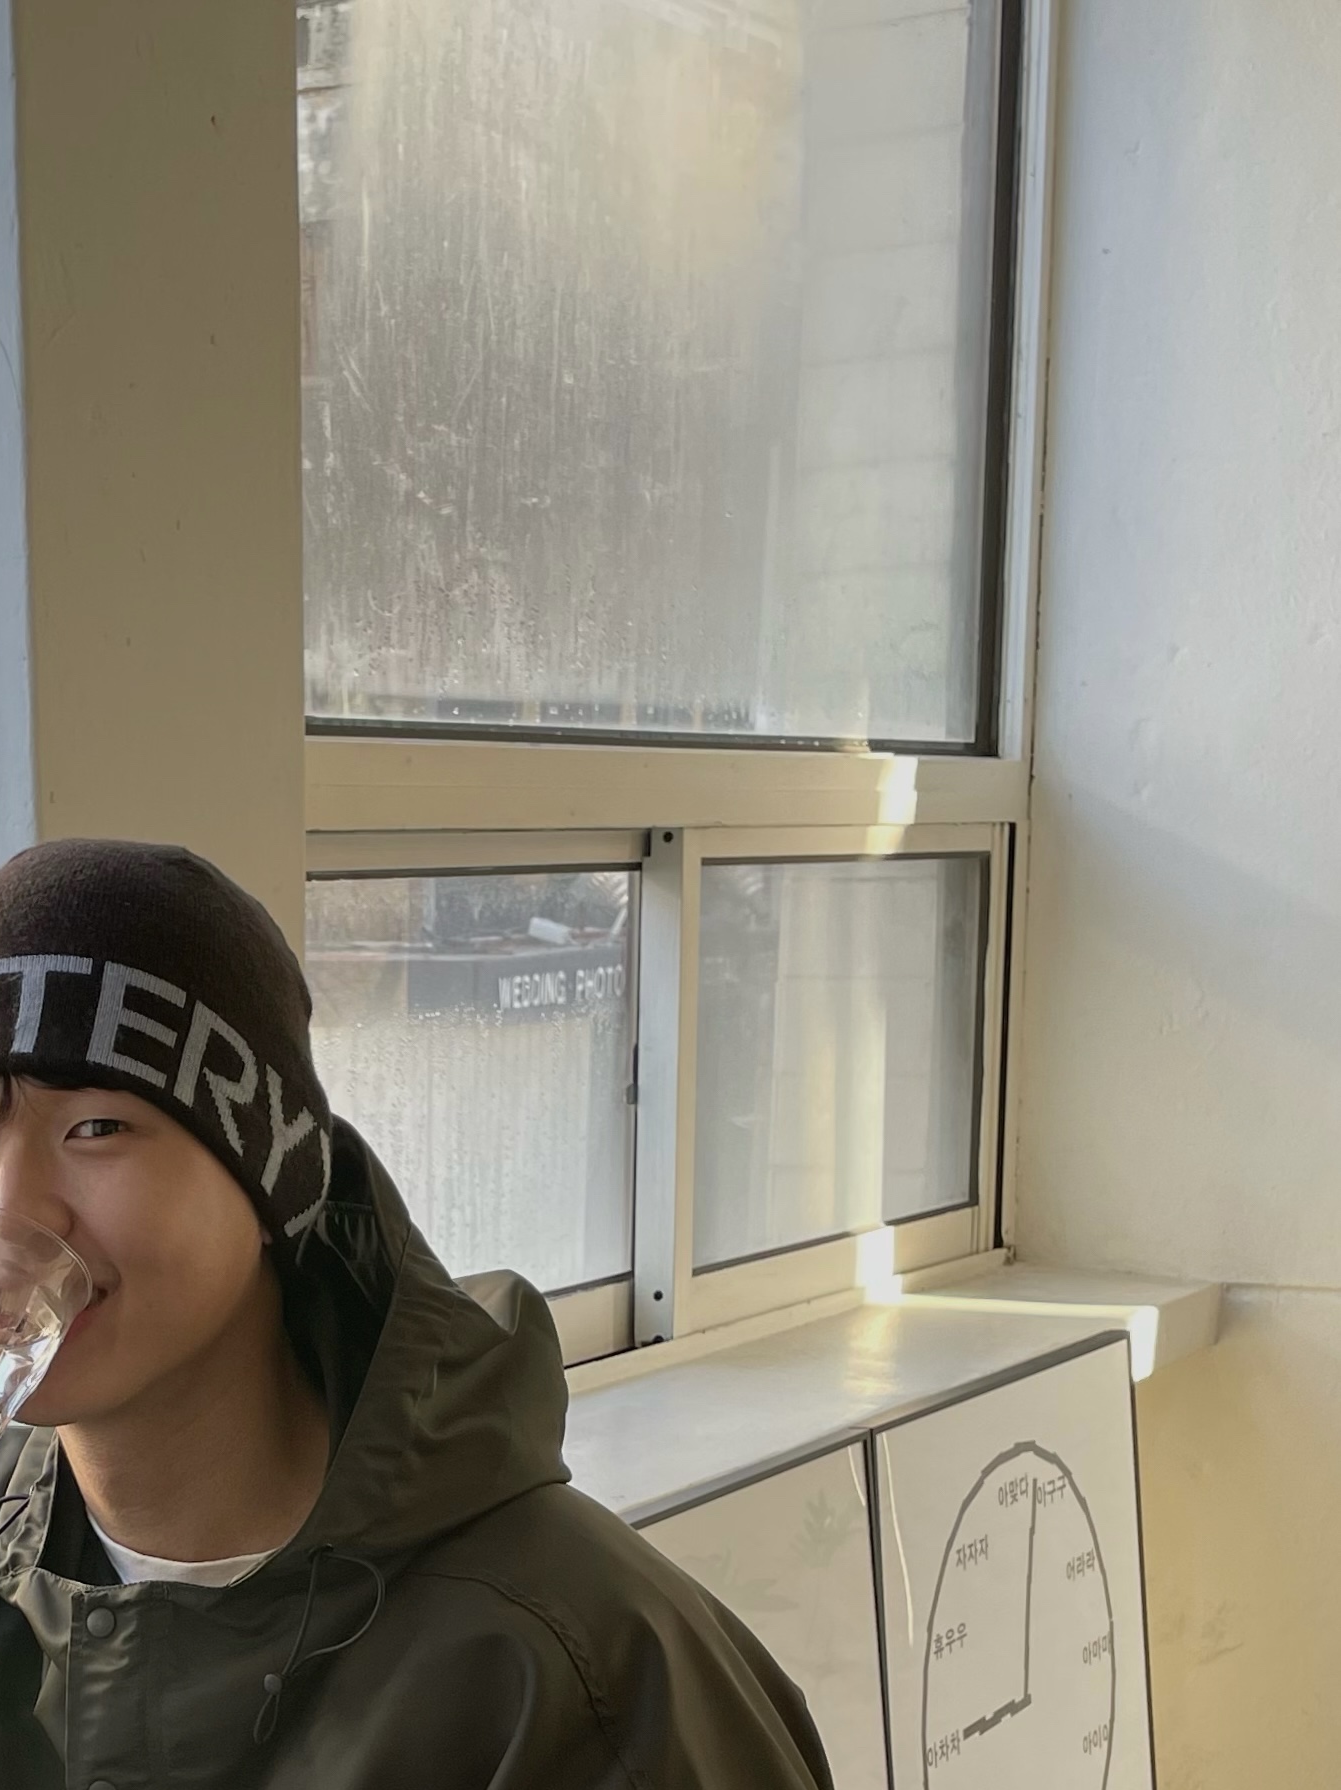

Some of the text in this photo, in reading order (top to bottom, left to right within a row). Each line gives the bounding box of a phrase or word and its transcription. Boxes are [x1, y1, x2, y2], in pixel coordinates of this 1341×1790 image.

[498, 963, 626, 1009] WEDDING PHOTO
[997, 1472, 1029, 1508] 아맞다
[1036, 1475, 1067, 1508] 아구구
[955, 1533, 989, 1571] 자자자
[1065, 1548, 1096, 1581] 어라라
[933, 1622, 968, 1660] 휴우우
[927, 1729, 961, 1768] 아차차
